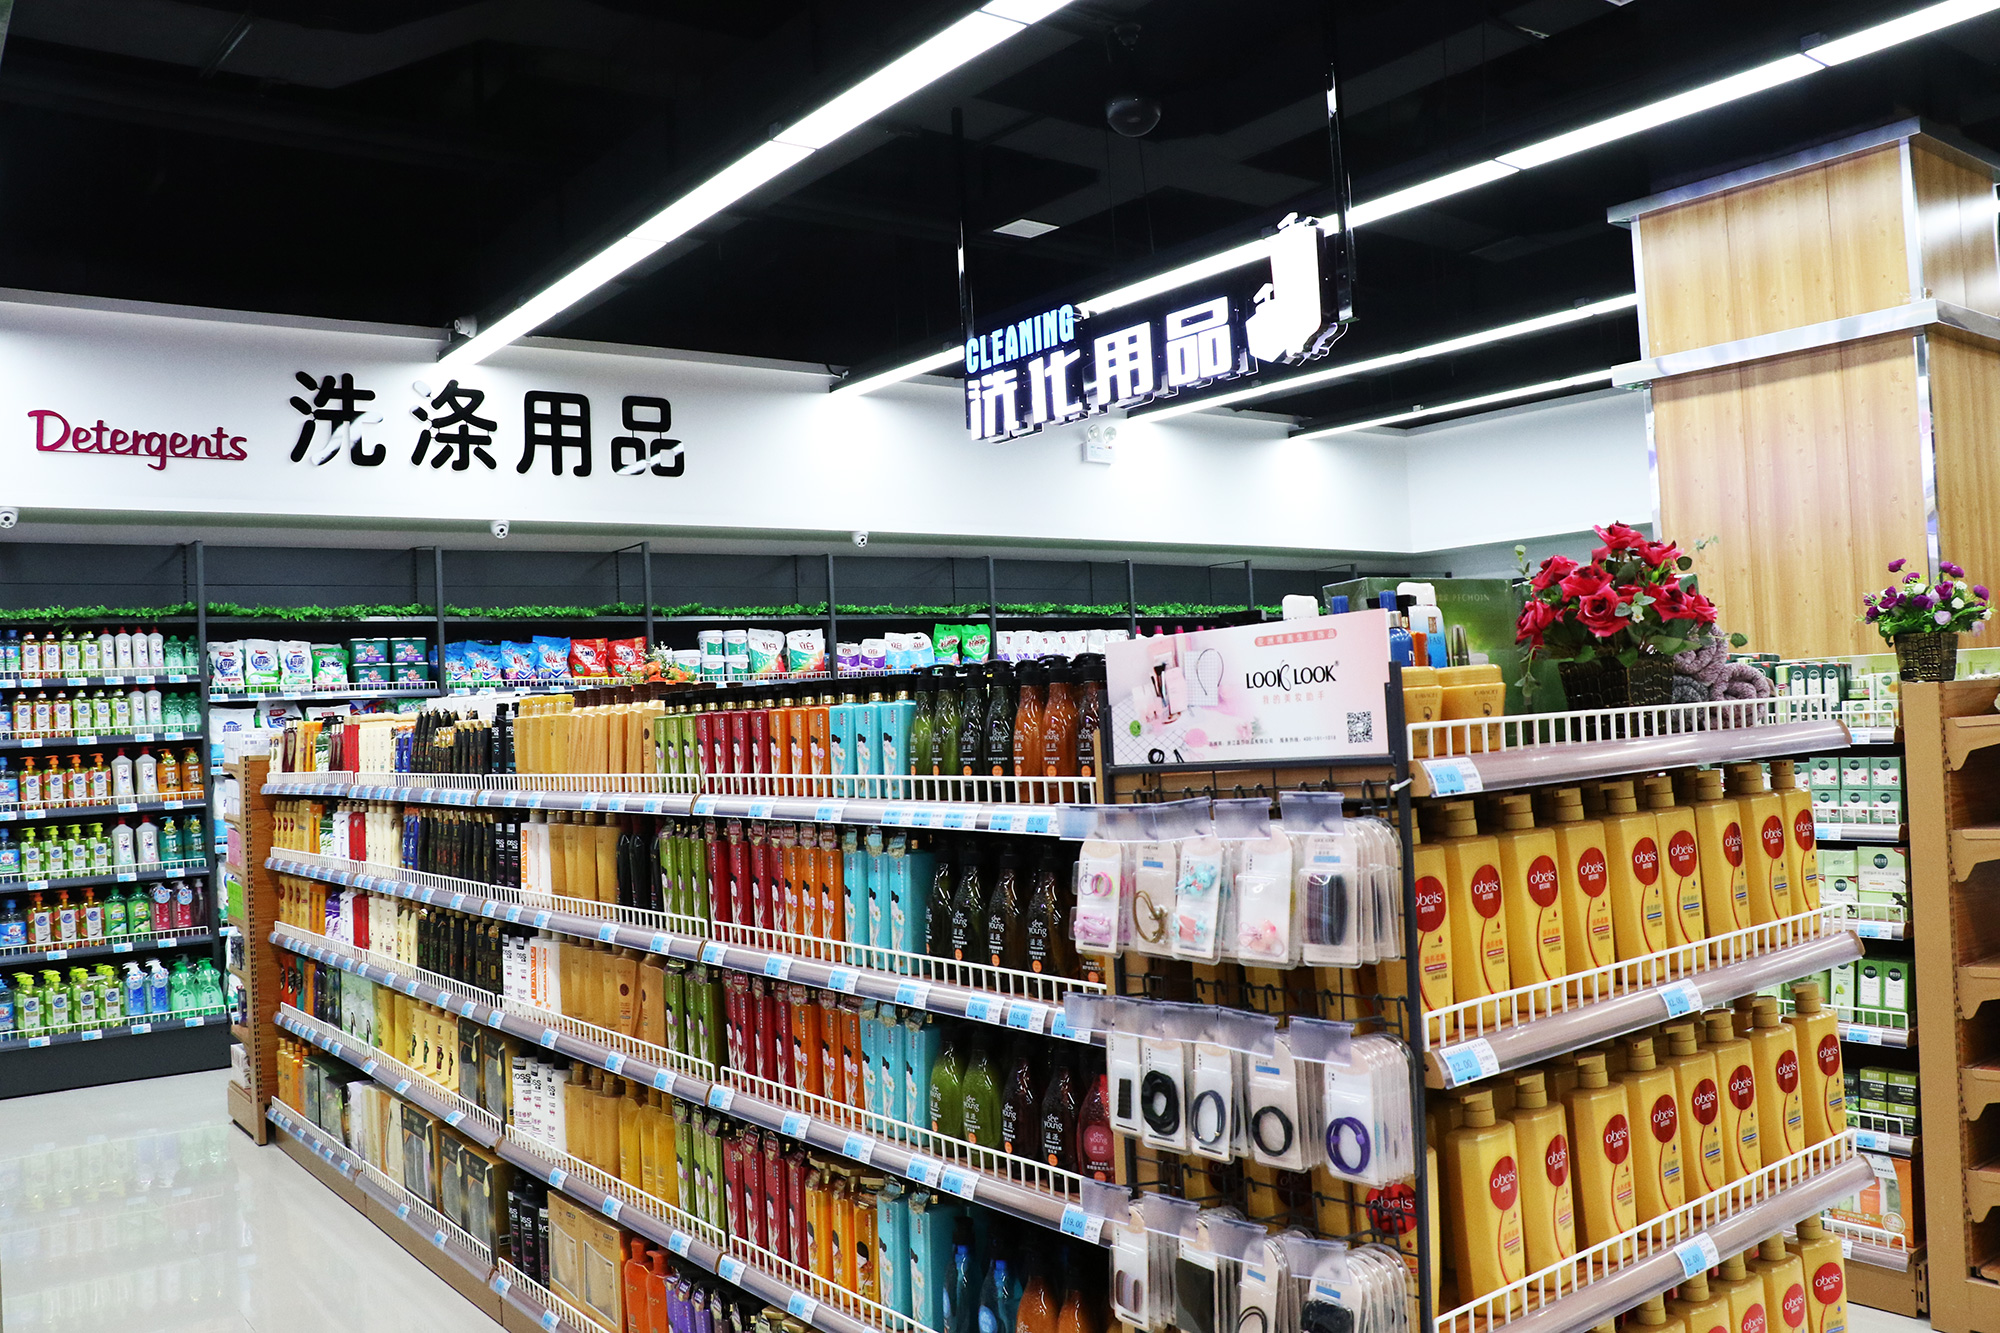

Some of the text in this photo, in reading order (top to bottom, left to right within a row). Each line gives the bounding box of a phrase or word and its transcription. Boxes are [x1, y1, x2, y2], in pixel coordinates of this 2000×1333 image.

[965, 304, 1075, 375] CLEANING
[967, 296, 1233, 441] 洗化用品
[289, 370, 685, 478] 洗涤用品
[28, 408, 248, 470] Detergents
[1634, 851, 1656, 864] obeis
[1671, 843, 1694, 857] obeis
[1580, 862, 1604, 876] obeis
[1530, 870, 1555, 885] obeis
[1474, 880, 1499, 895] obeis
[1819, 1045, 1838, 1058] obeis
[1778, 1061, 1797, 1075] obeis
[1731, 1077, 1752, 1091] obeis
[1694, 1090, 1716, 1105] obeis
[1653, 1107, 1674, 1123] obeis
[1605, 1128, 1627, 1144] obeis
[1492, 1170, 1516, 1189] obeis
[1815, 1272, 1840, 1287] obeis
[1784, 1293, 1803, 1310] obeis
